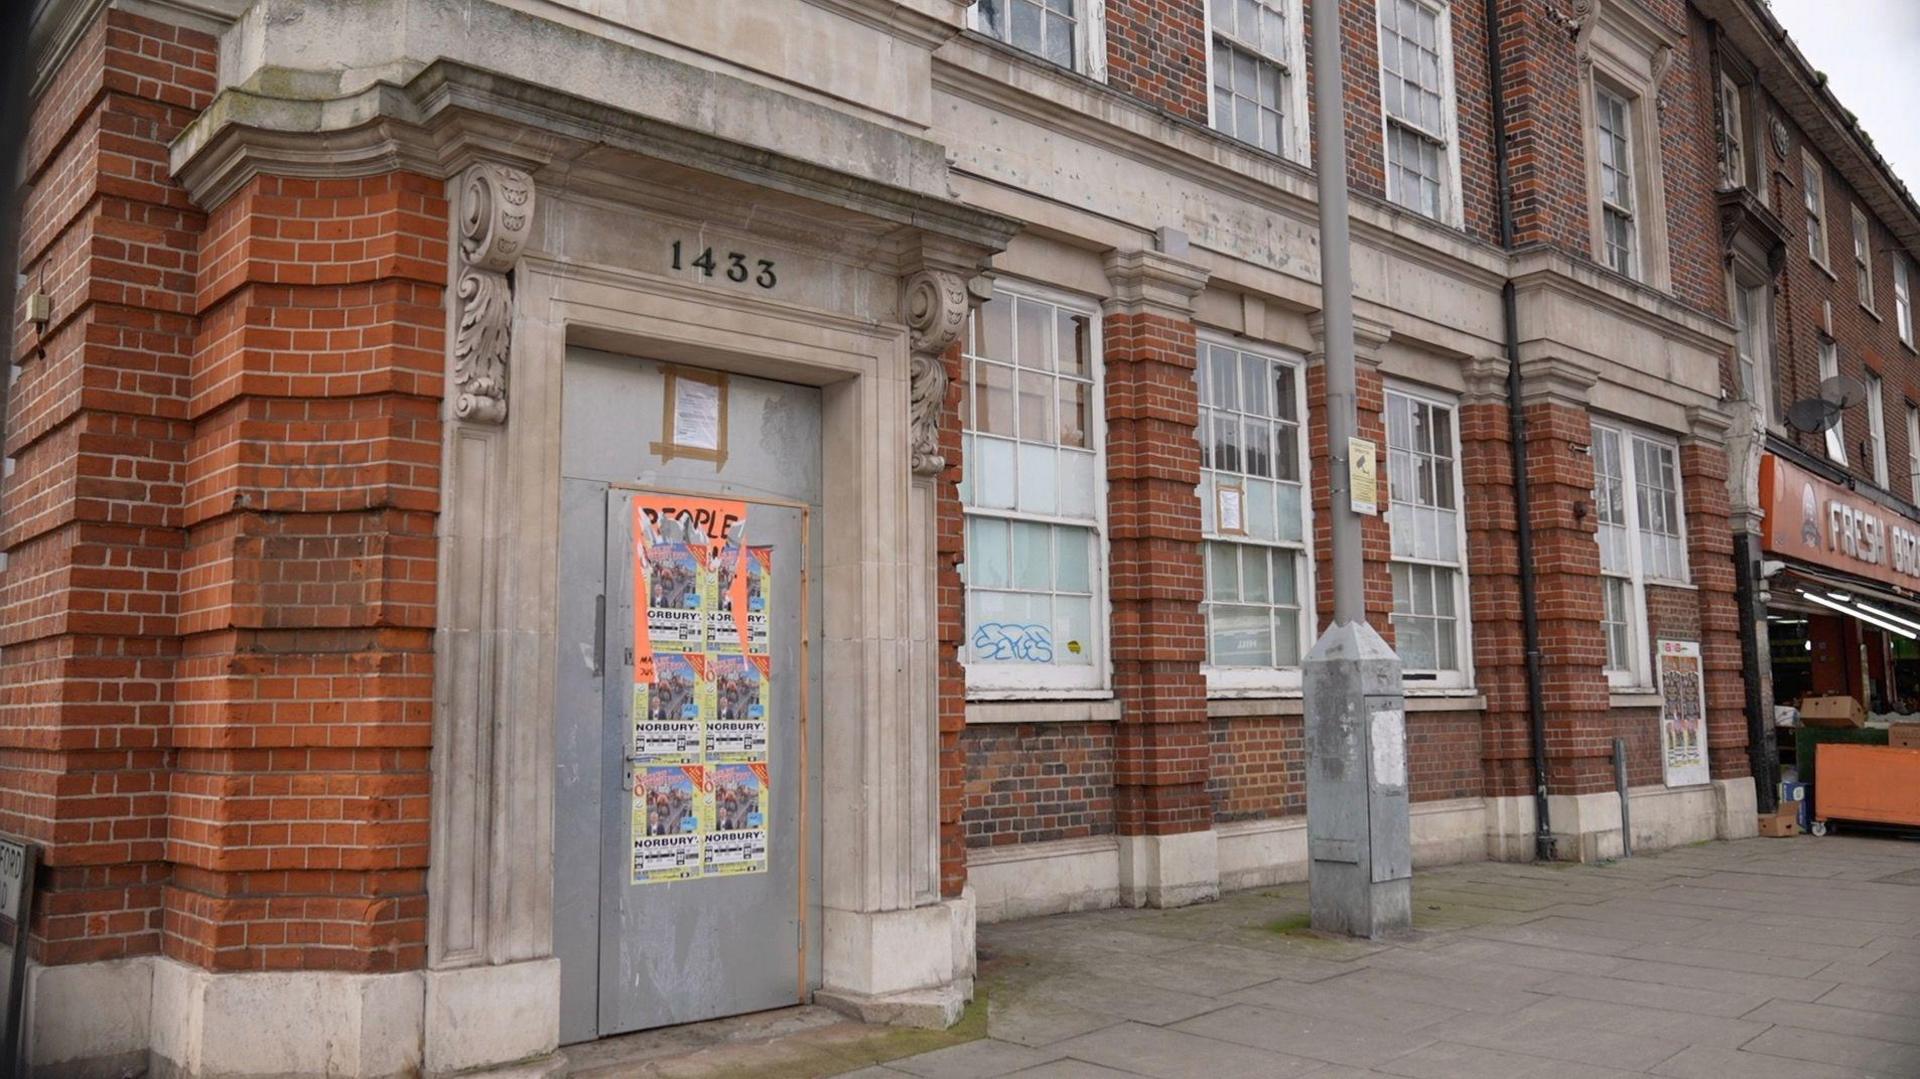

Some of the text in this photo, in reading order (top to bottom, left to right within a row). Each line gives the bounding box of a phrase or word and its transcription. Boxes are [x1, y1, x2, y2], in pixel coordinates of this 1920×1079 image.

[671, 240, 777, 289] 1433
[1829, 500, 1887, 566] FRESH
[647, 610, 698, 620] ORBURY
